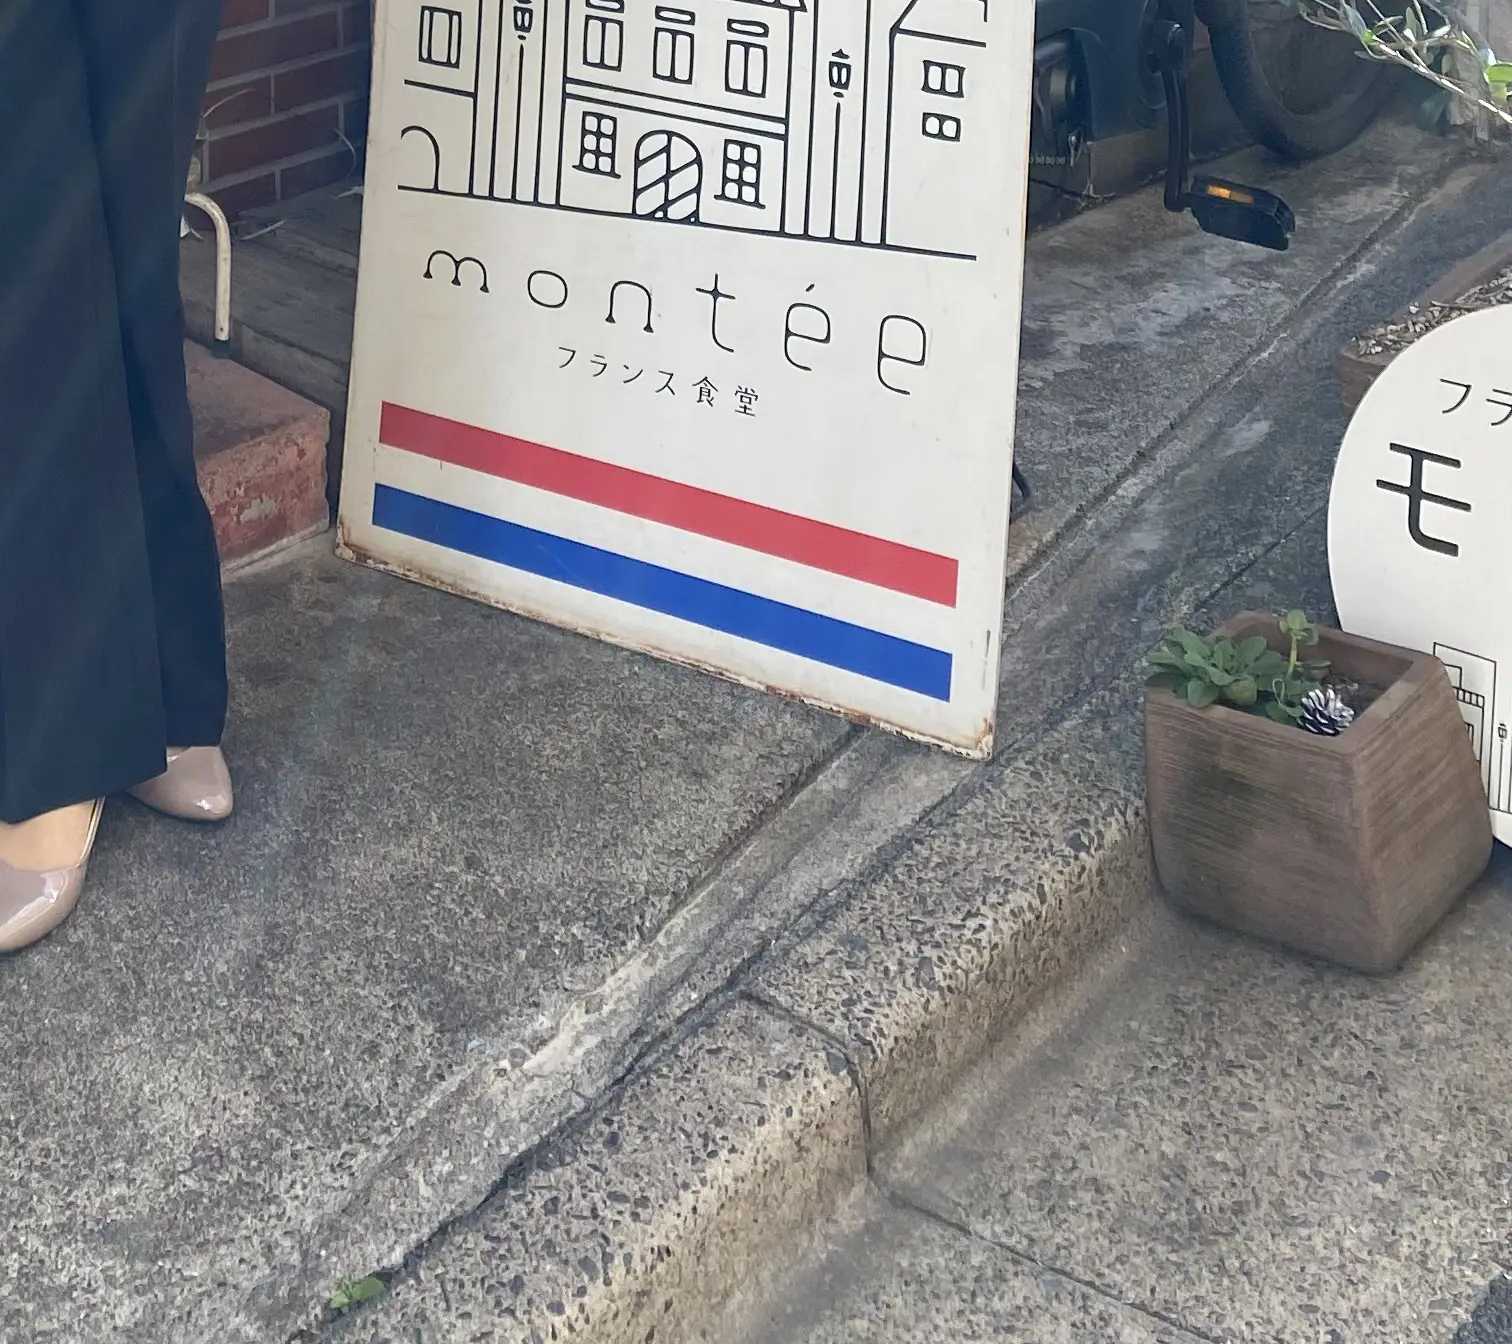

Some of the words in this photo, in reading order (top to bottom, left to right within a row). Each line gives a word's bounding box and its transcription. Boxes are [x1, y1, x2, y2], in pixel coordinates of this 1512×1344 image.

[422, 249, 928, 396] montée
[557, 345, 760, 419] フランス食堂
[1439, 377, 1512, 427] フラ
[1375, 442, 1473, 558] モ
